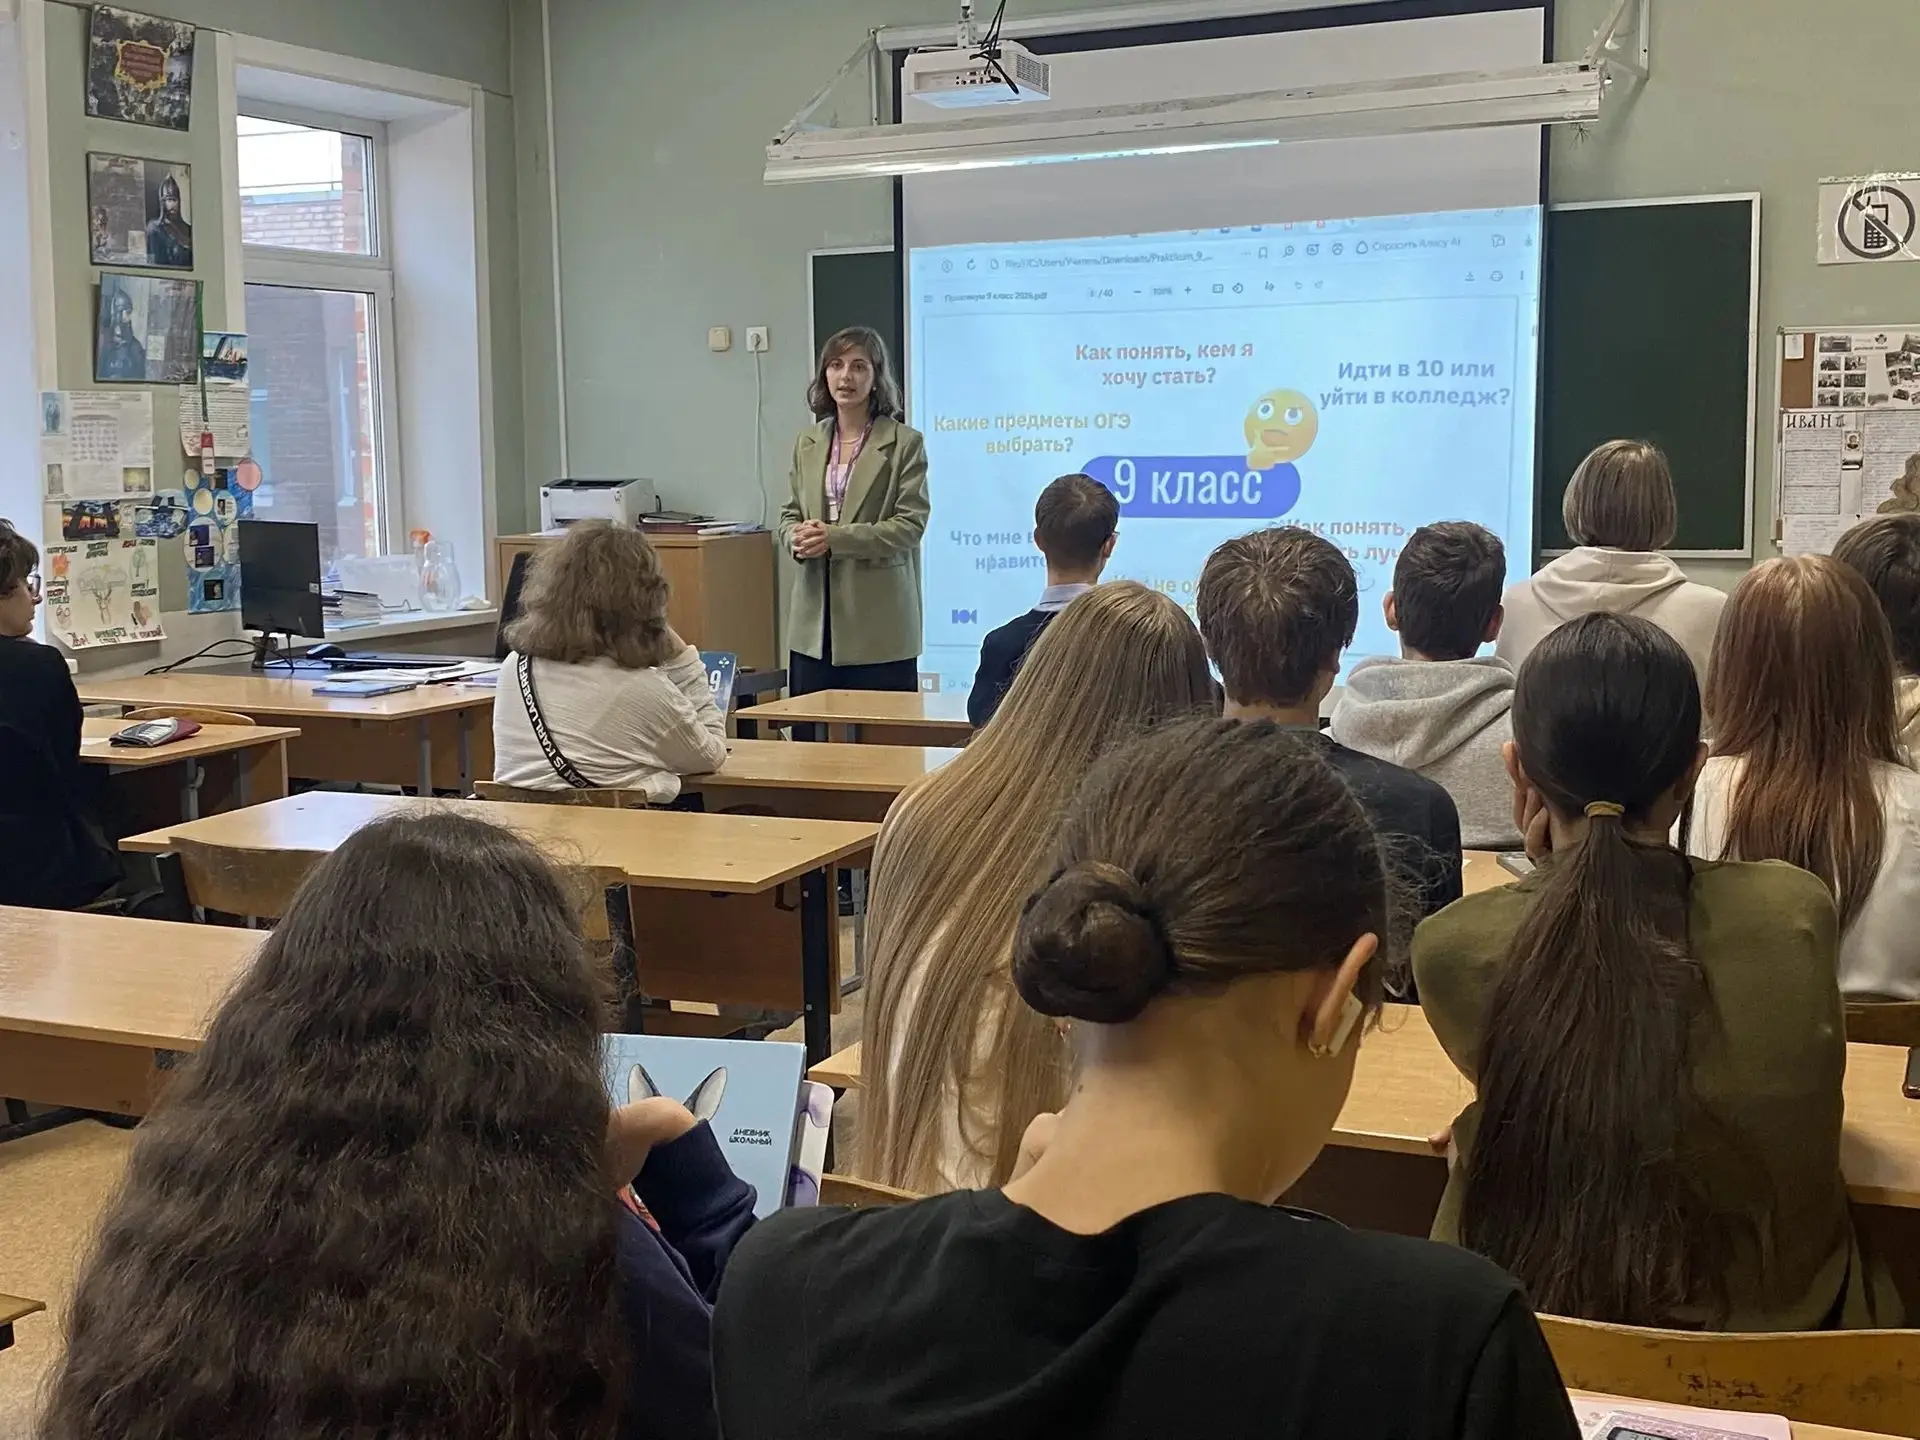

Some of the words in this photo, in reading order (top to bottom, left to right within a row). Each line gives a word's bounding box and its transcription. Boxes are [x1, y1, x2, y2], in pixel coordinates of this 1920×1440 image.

[1075, 344, 1111, 360] Как
[1117, 344, 1191, 362] понять,
[1198, 342, 1235, 358] кем
[1241, 343, 1254, 357] я
[1102, 372, 1147, 389] хочу
[1152, 367, 1216, 385] стать?
[1338, 362, 1391, 381] Идти
[1399, 363, 1410, 377] в
[1416, 360, 1444, 378] 10
[1451, 363, 1495, 378] или
[1320, 386, 1367, 410] уйти
[1374, 390, 1385, 404] в
[1391, 387, 1510, 407] колледж?
[934, 415, 989, 432] Какие
[994, 412, 1088, 432] предметы
[1094, 413, 1131, 429] ОГЭ
[1787, 413, 1831, 429] ИВАН
[986, 437, 1074, 456] выбрать?
[1114, 458, 1136, 504] 9
[1152, 470, 1262, 505] класс
[950, 531, 982, 546] Что
[987, 532, 1021, 545] мне
[519, 655, 540, 721] LAGERFEL
[709, 669, 722, 692] 9
[536, 718, 557, 757] KARL
[553, 756, 567, 771] IS
[729, 1136, 772, 1146] ШКОЛЬНЫЙ
[733, 1128, 771, 1137] ДНЕВНИК
